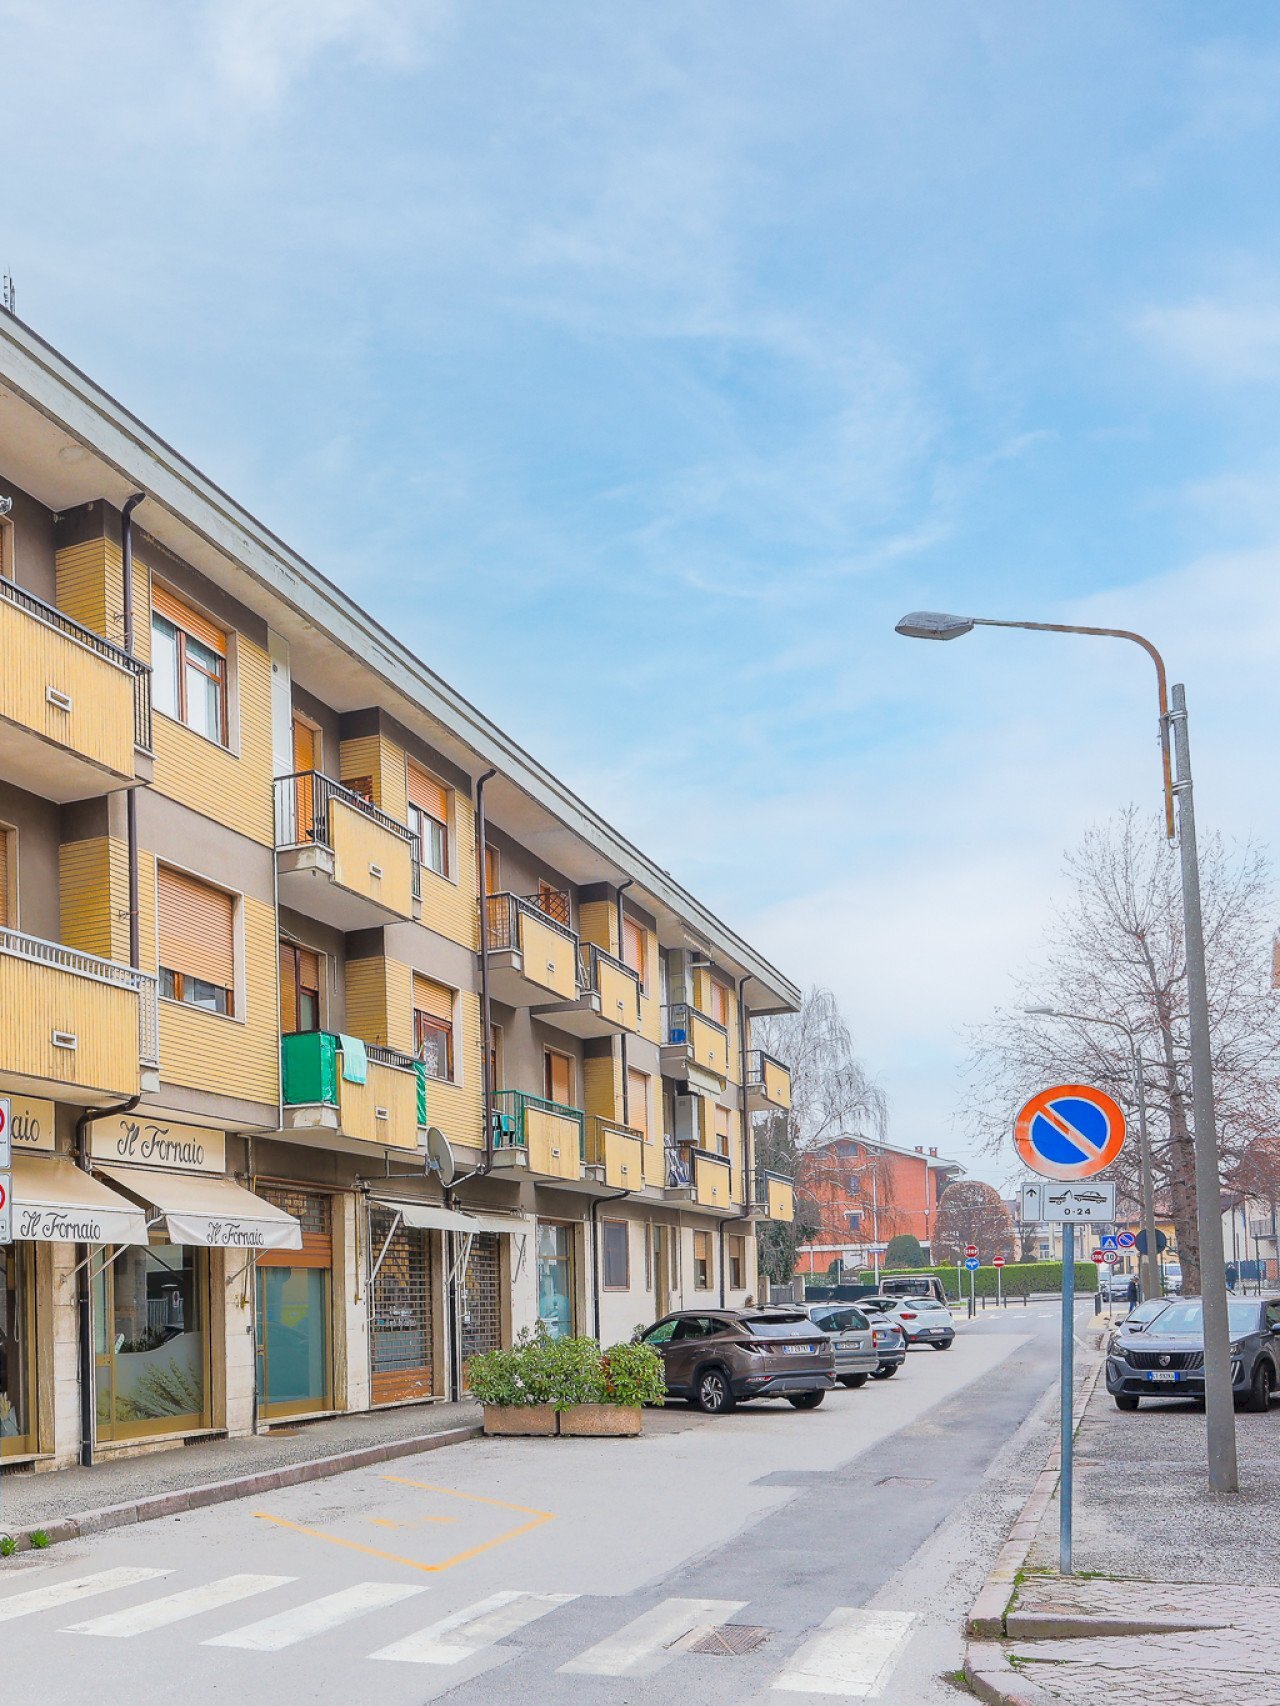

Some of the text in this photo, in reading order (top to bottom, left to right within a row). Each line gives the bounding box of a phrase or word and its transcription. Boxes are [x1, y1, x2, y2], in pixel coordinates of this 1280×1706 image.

[116, 1120, 205, 1165] Il Fornaio
[20, 1210, 102, 1241] Il Fornaio
[205, 1221, 265, 1247] Il Fornaio
